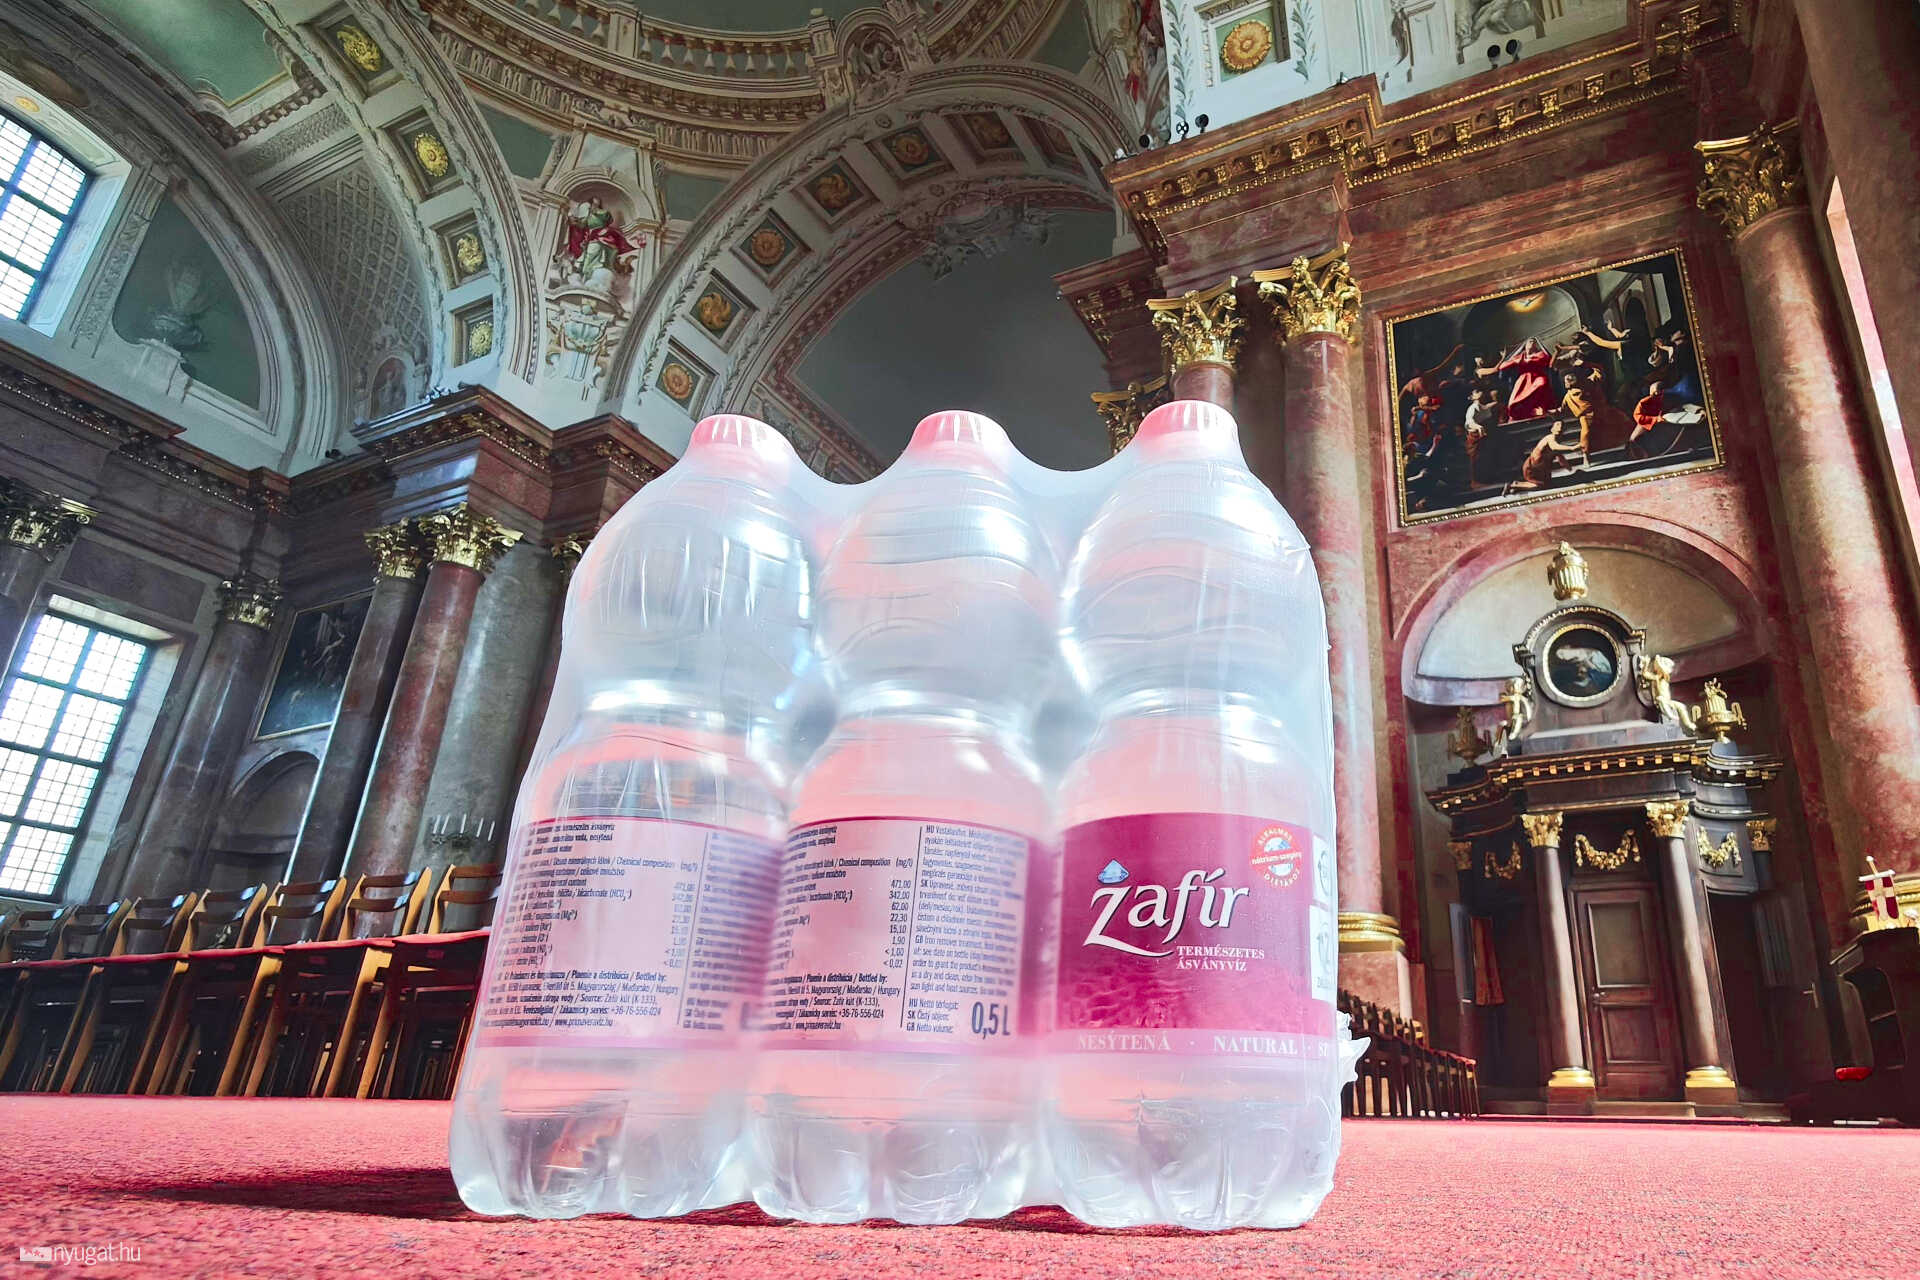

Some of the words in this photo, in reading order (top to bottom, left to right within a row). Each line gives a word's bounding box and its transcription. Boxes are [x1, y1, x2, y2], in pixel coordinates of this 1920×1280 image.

[1083, 867, 1250, 958] Zafír
[1176, 944, 1265, 960] TERMÉSZETES
[1175, 957, 1247, 972] ÁSVÁNYVÍZ
[878, 986, 900, 997] Hungary
[1213, 1035, 1298, 1056] NATURAL
